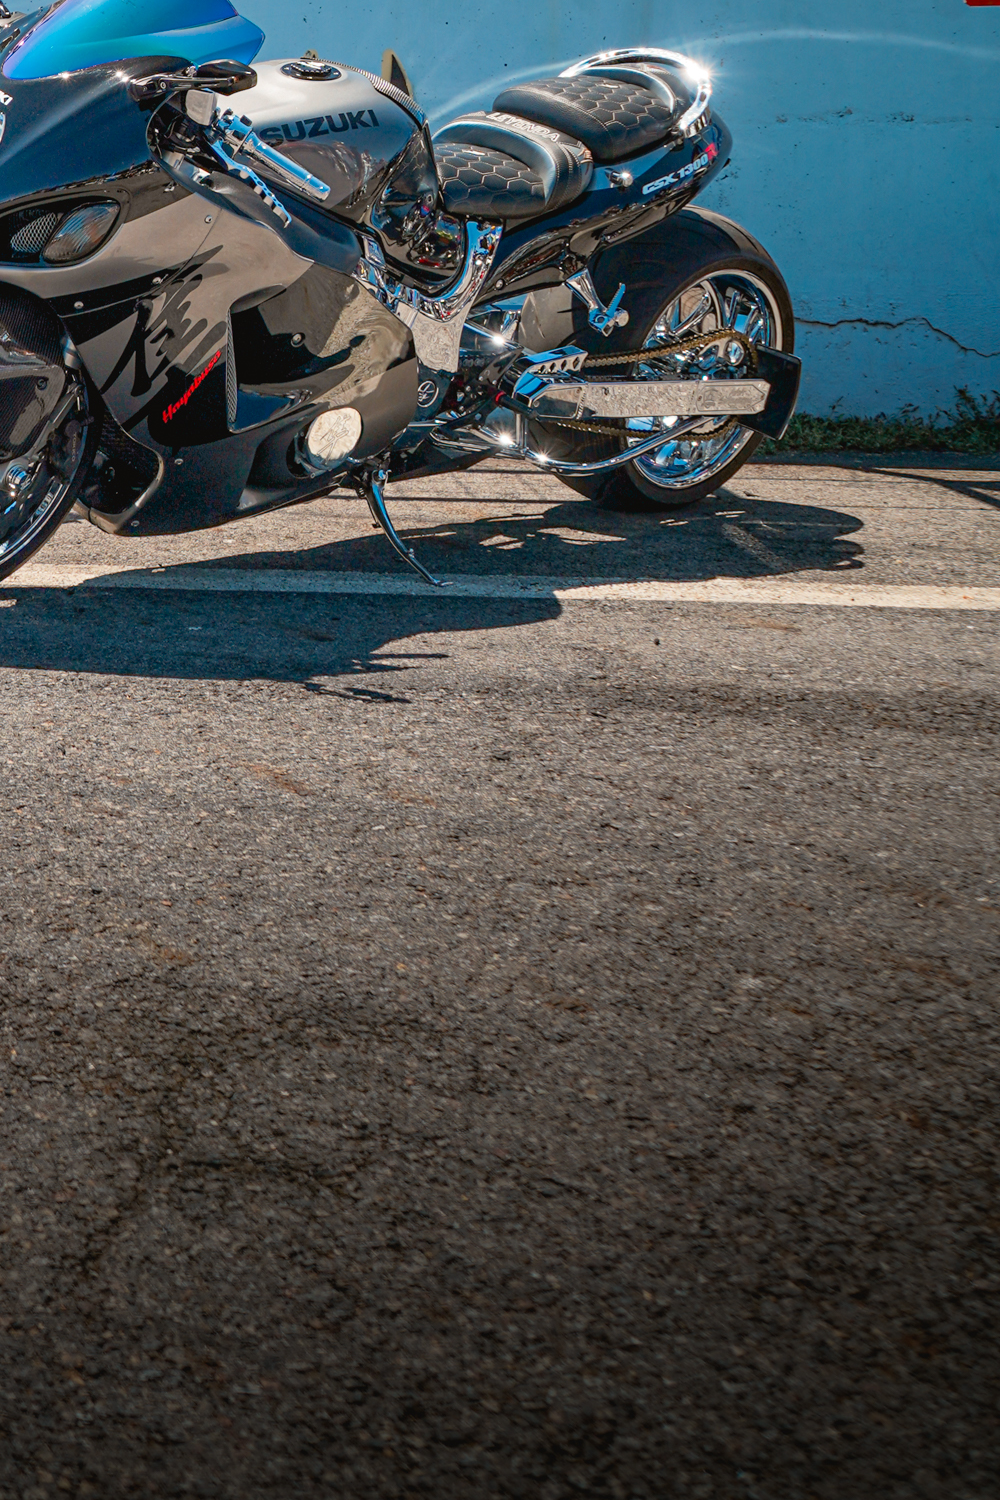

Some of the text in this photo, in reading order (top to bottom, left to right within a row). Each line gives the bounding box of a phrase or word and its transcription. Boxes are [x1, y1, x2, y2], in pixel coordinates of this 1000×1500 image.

[259, 109, 380, 148] SUZUKI
[485, 111, 561, 142] LEYENDA
[641, 174, 679, 195] GSX
[162, 350, 222, 424] Hayabusa
